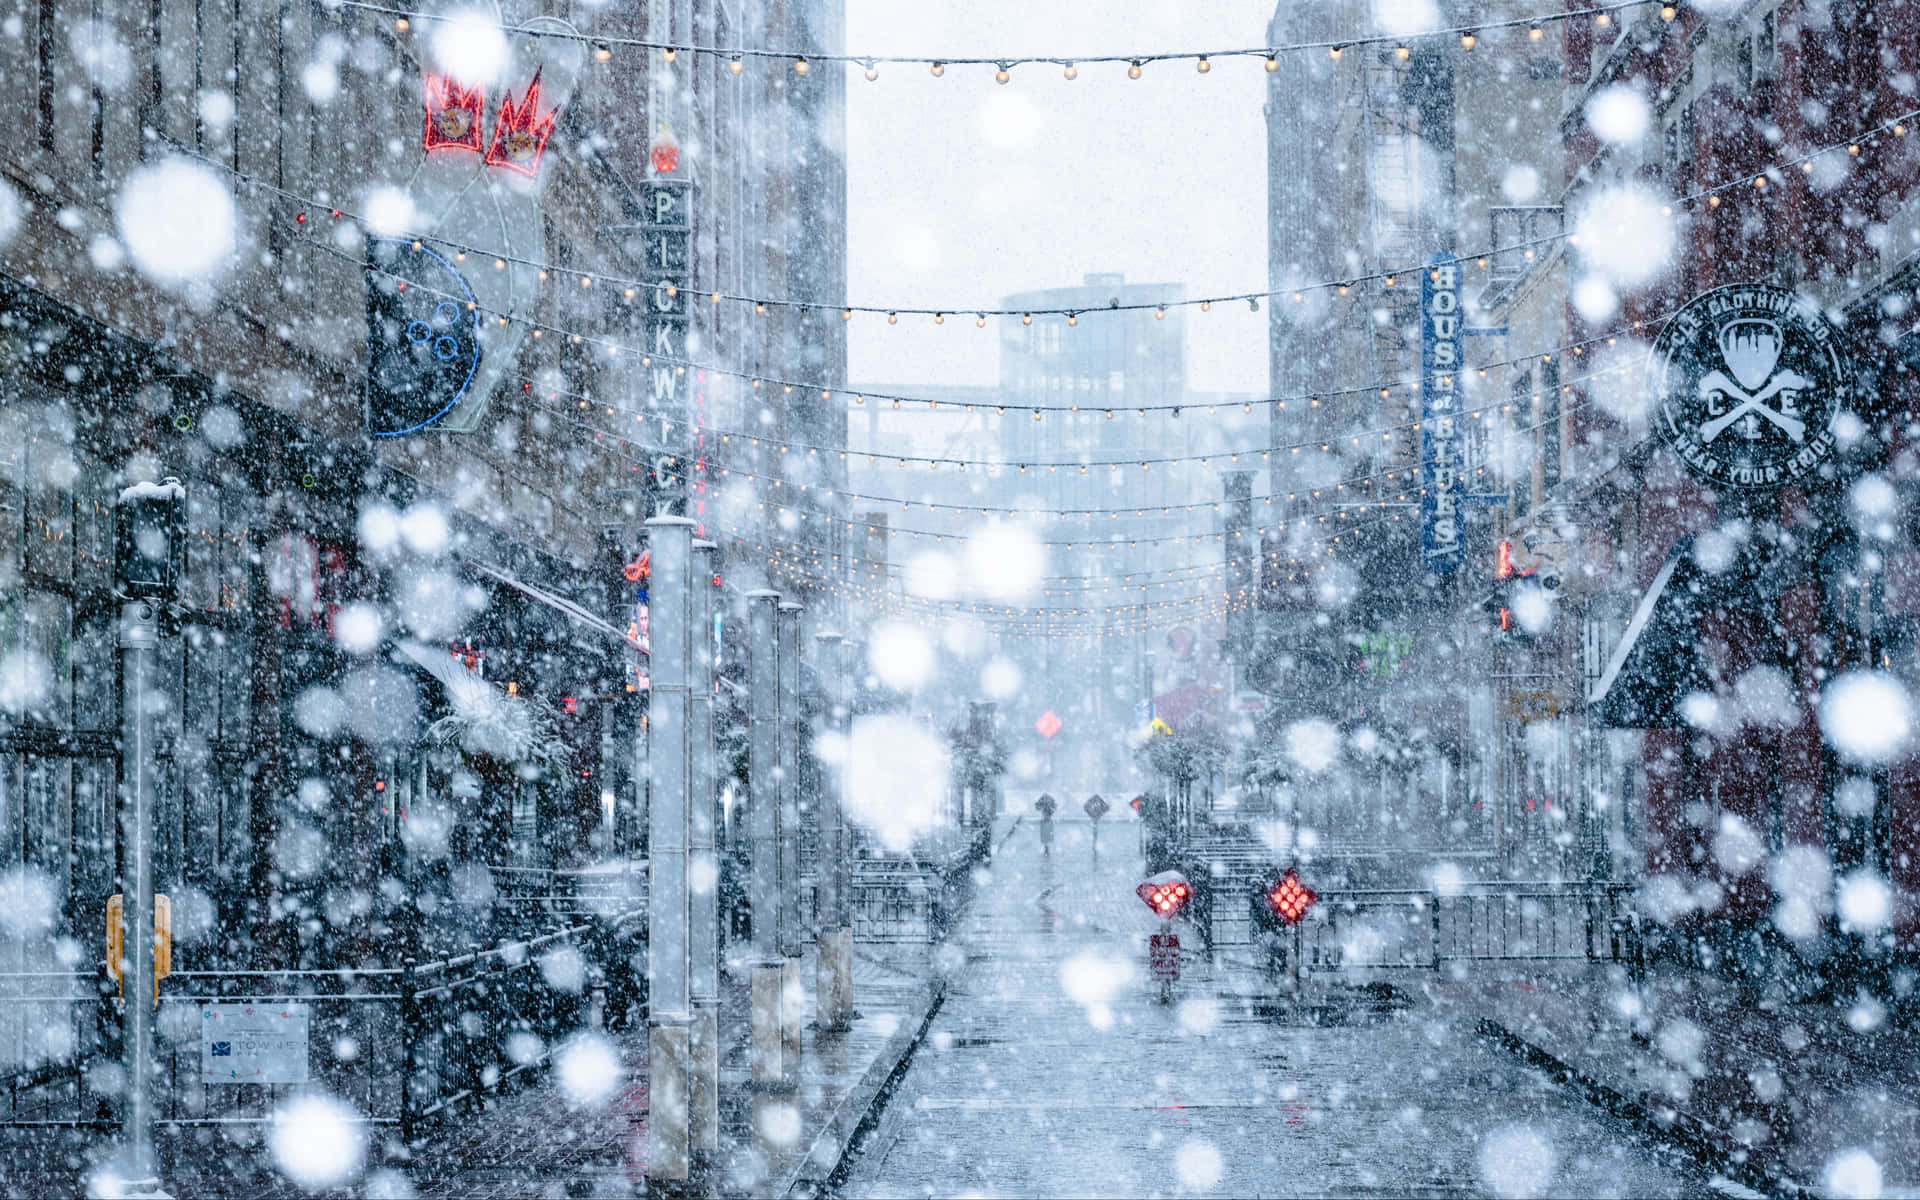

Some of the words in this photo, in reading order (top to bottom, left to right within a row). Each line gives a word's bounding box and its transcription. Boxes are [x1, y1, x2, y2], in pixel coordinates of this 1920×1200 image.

[1432, 266, 1457, 392] HOUSE
[1708, 291, 1799, 322] CLOTHING
[1433, 396, 1452, 409] of
[1434, 417, 1456, 543] BLUES
[1674, 432, 1717, 475] WEAR
[1729, 467, 1777, 484] YOUR
[1787, 430, 1835, 478] PRIDE
